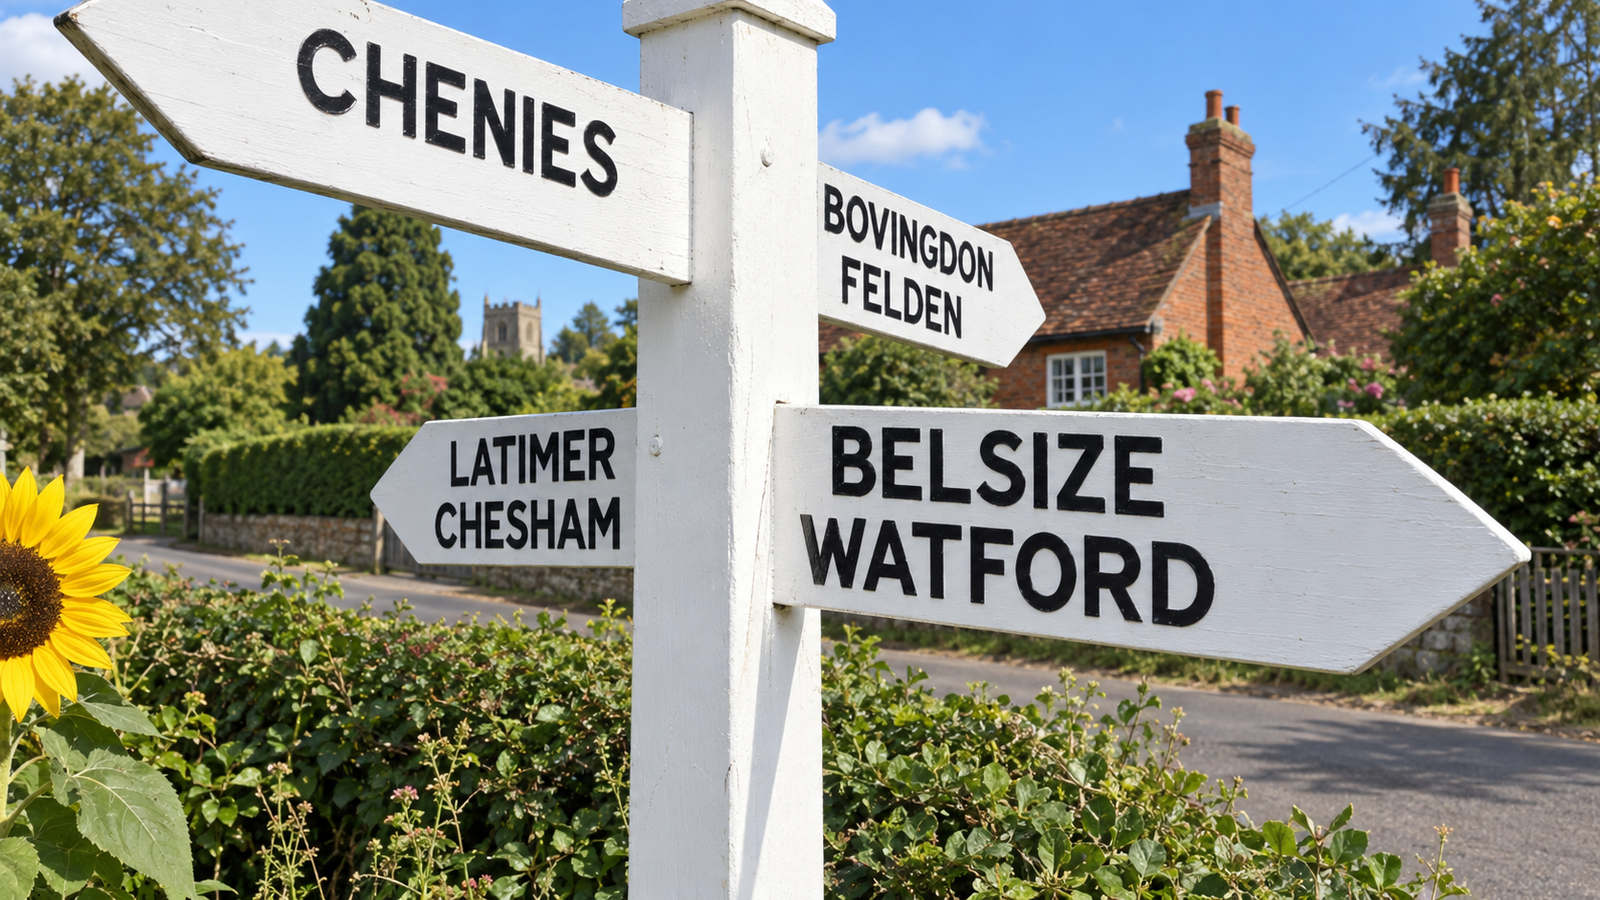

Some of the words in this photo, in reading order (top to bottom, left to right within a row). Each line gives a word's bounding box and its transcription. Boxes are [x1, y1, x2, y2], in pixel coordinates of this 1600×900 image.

[296, 28, 618, 197] CHENIES
[824, 183, 993, 292] BOVINGDON
[841, 255, 962, 339] FELDEN
[450, 427, 616, 488] LATIMER
[831, 425, 1165, 519] BELSIZE
[434, 496, 621, 550] CHESHAM
[800, 514, 1215, 628] WATFORD
